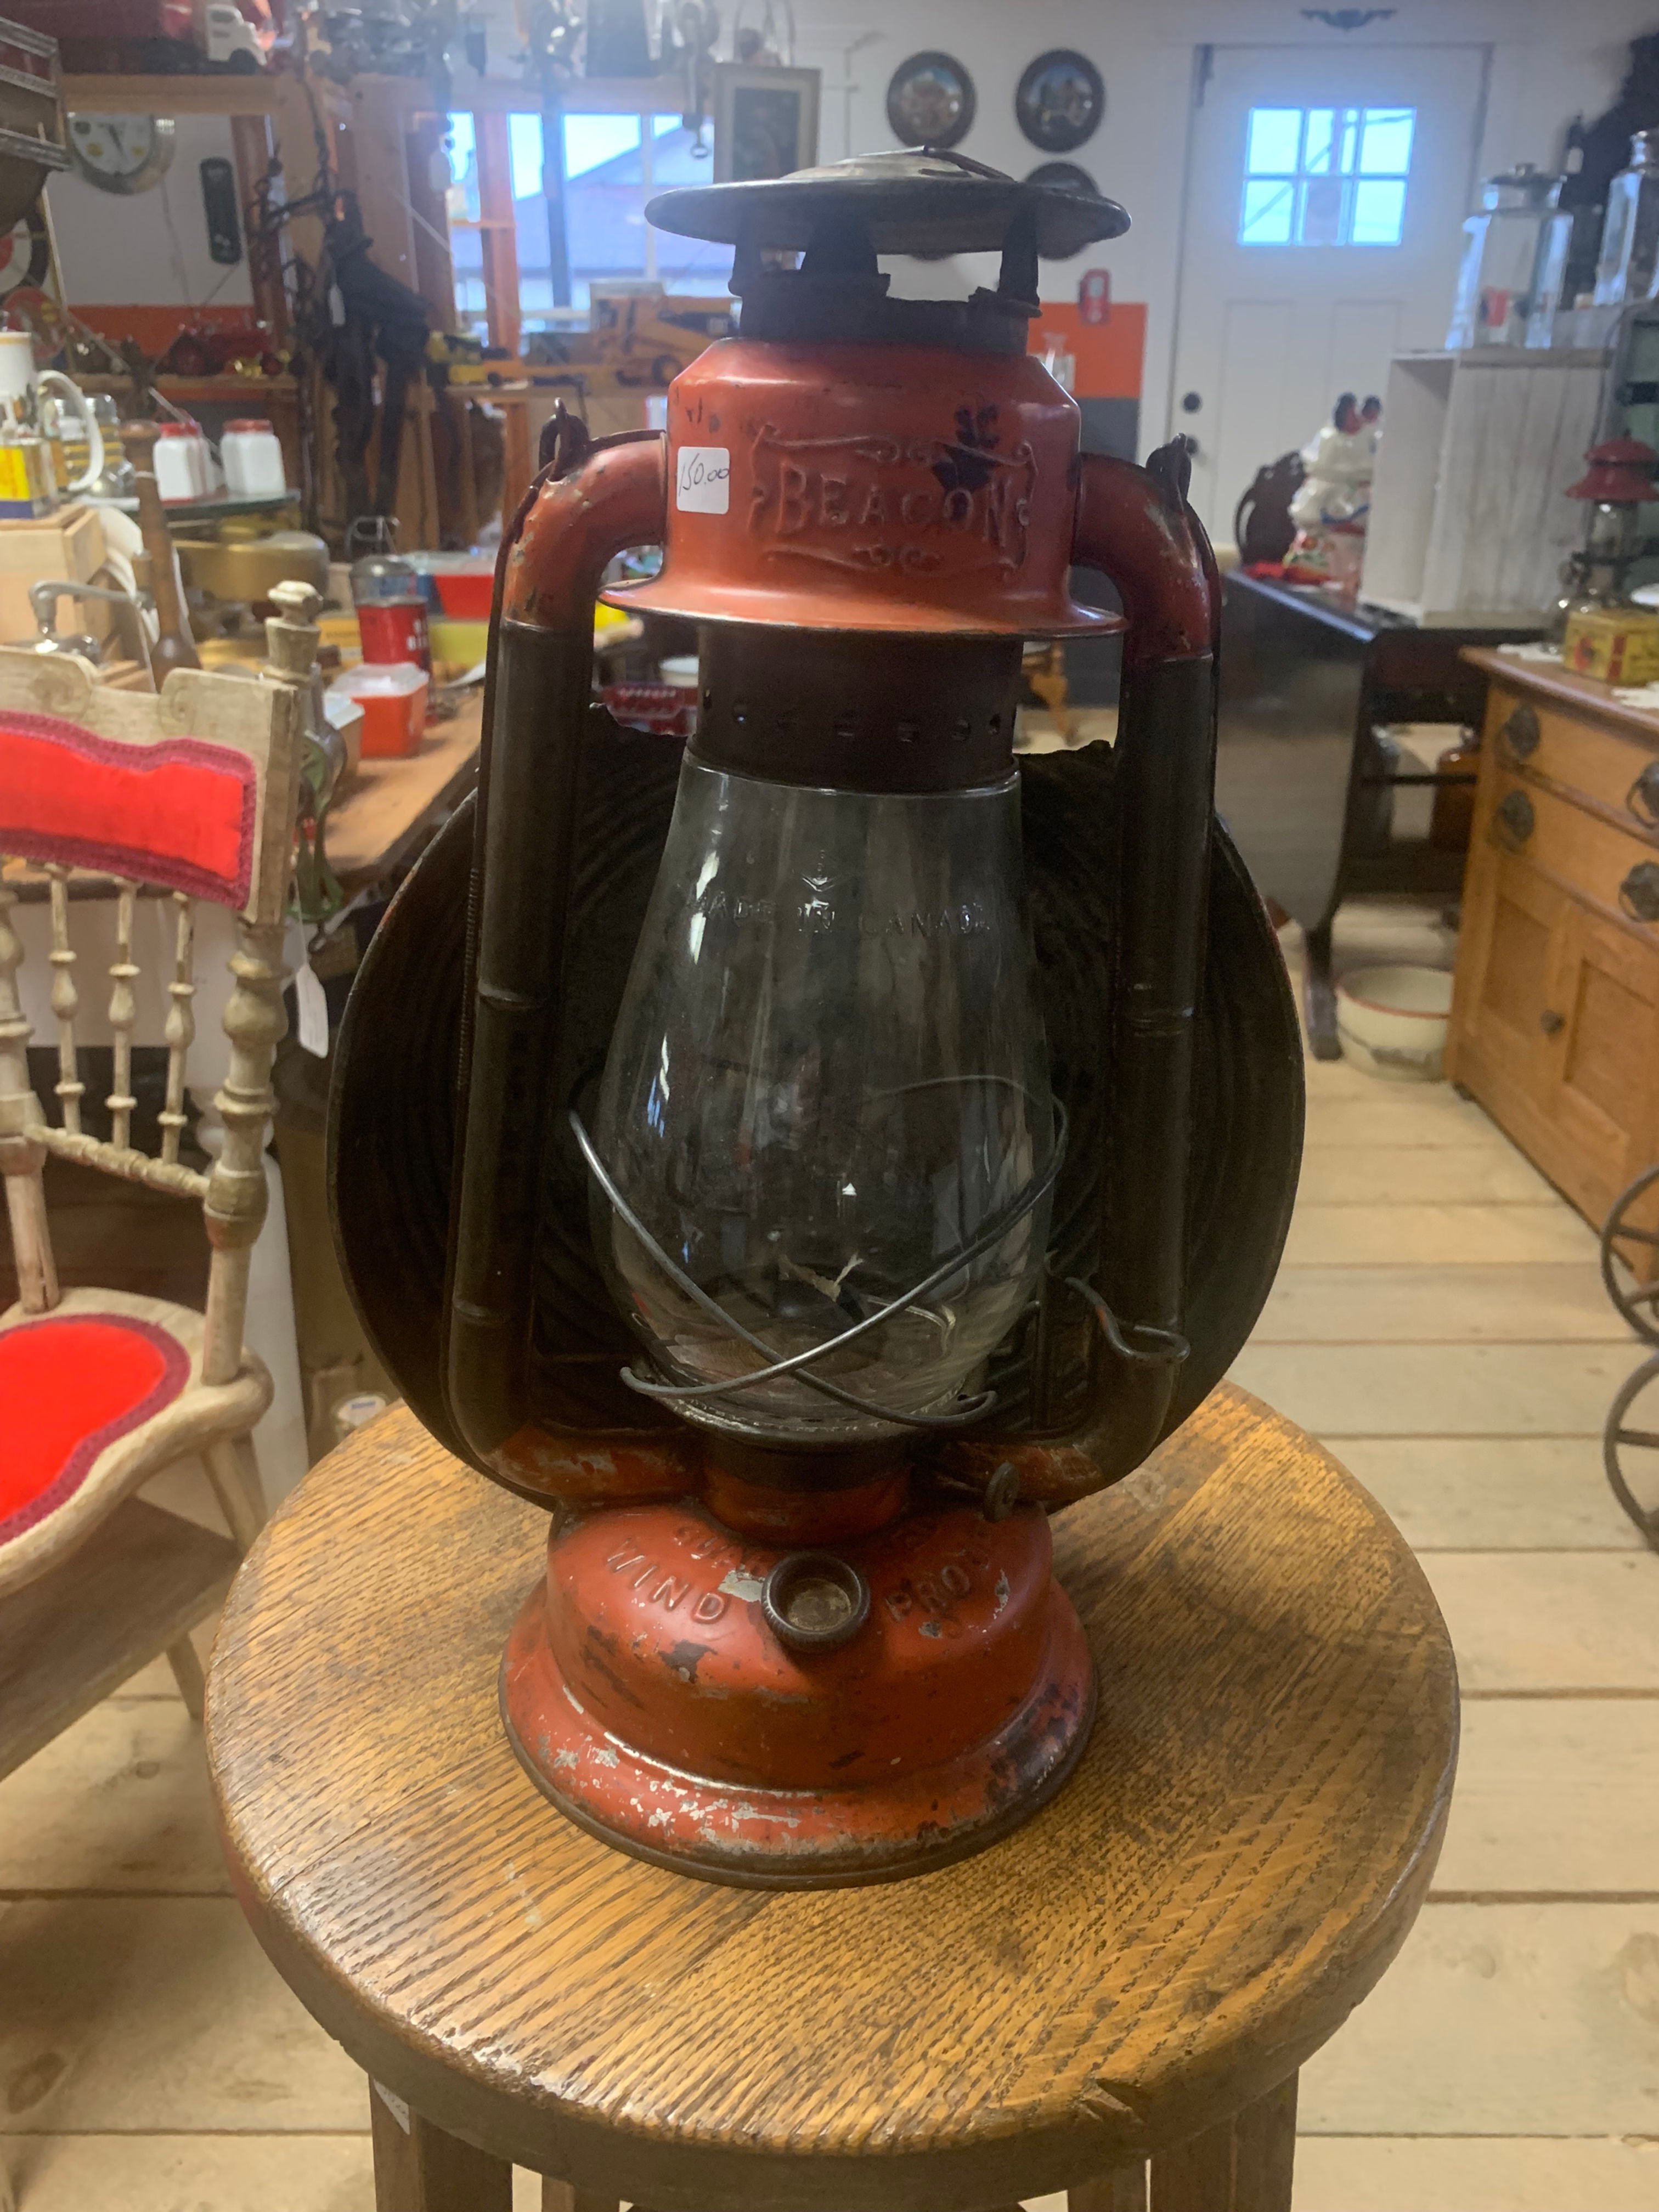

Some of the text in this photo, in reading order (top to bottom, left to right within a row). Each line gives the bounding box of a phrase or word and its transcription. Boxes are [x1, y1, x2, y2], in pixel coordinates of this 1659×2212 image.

[678, 453, 730, 497] 150.00
[774, 458, 1009, 549] BEACON
[857, 901, 991, 936] CANADA
[605, 1536, 730, 1624] WIND
